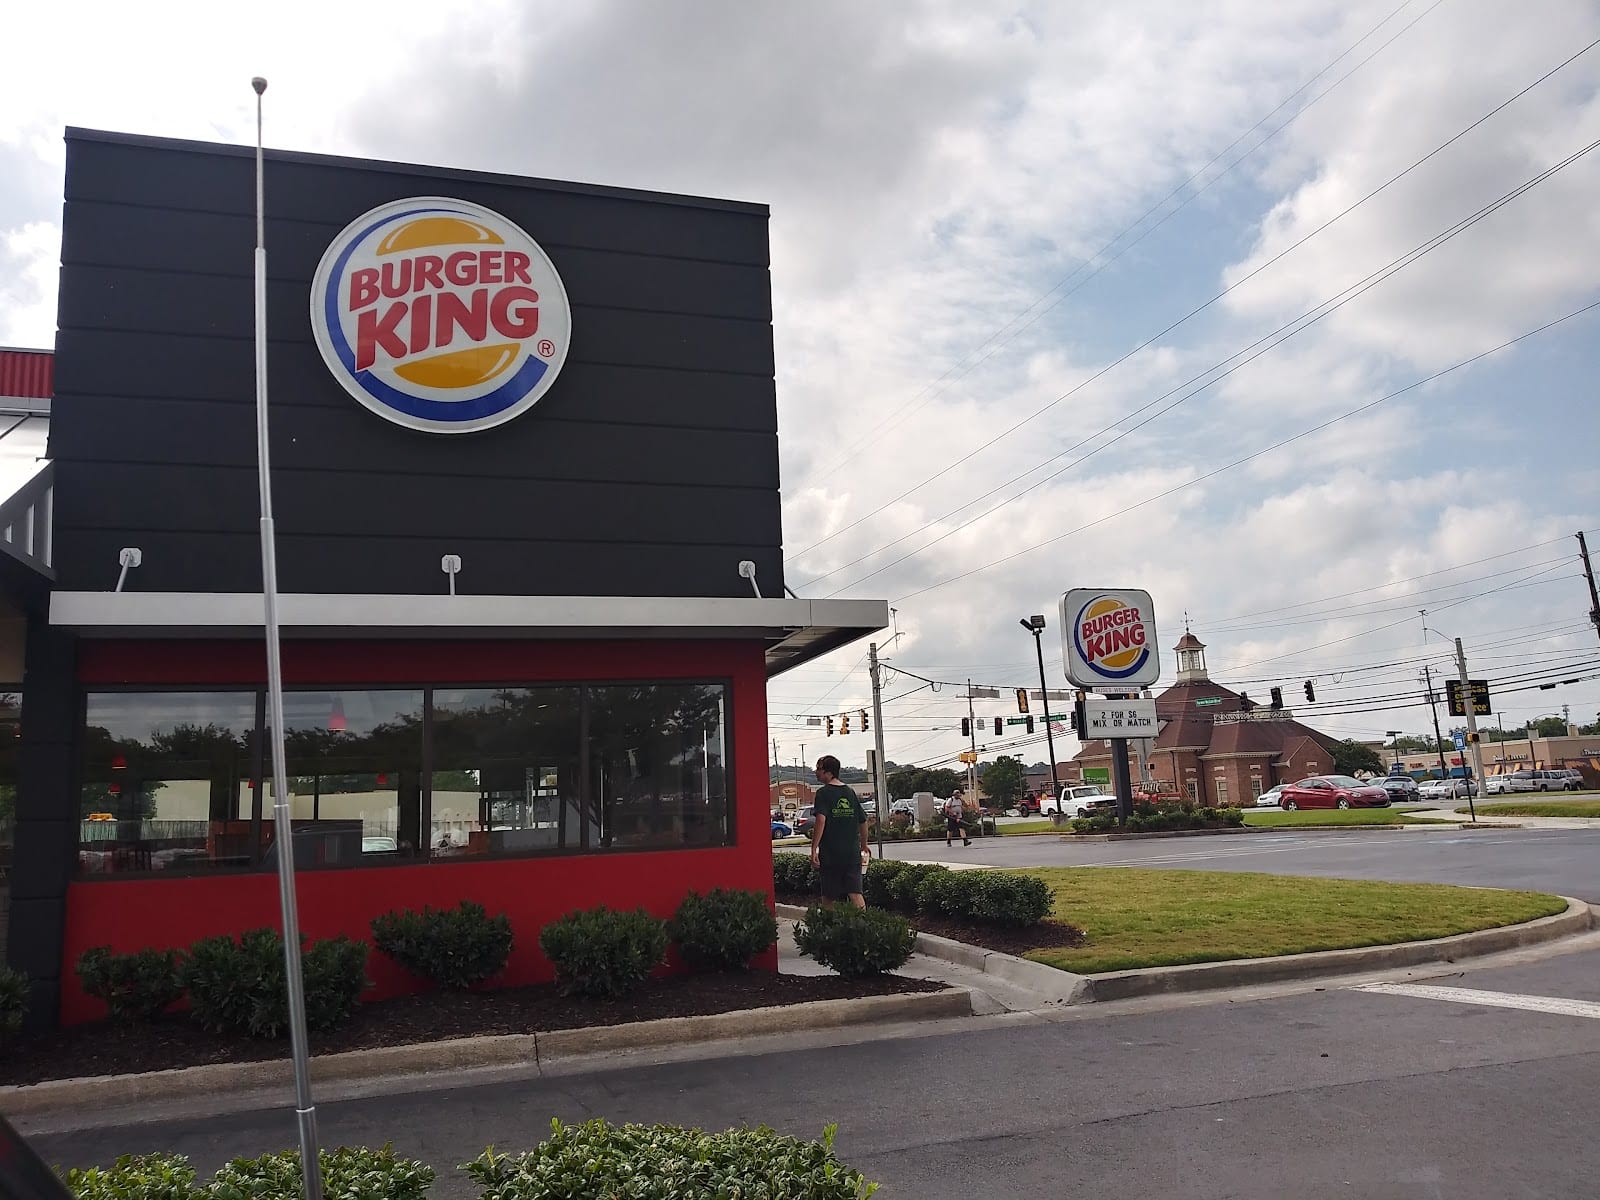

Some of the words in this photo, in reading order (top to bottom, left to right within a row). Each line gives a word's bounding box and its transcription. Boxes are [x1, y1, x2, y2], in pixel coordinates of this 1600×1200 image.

[349, 251, 532, 312] BURGER
[356, 286, 539, 370] KING
[1082, 607, 1141, 640] BURGER
[1087, 624, 1145, 662] KING
[1092, 719, 1107, 728] MIX
[1113, 719, 1123, 727] OR
[1127, 718, 1151, 727] MATCH
[1101, 711, 1106, 719] 2
[1111, 710, 1124, 719] FOR
[1455, 702, 1488, 713] Srce
